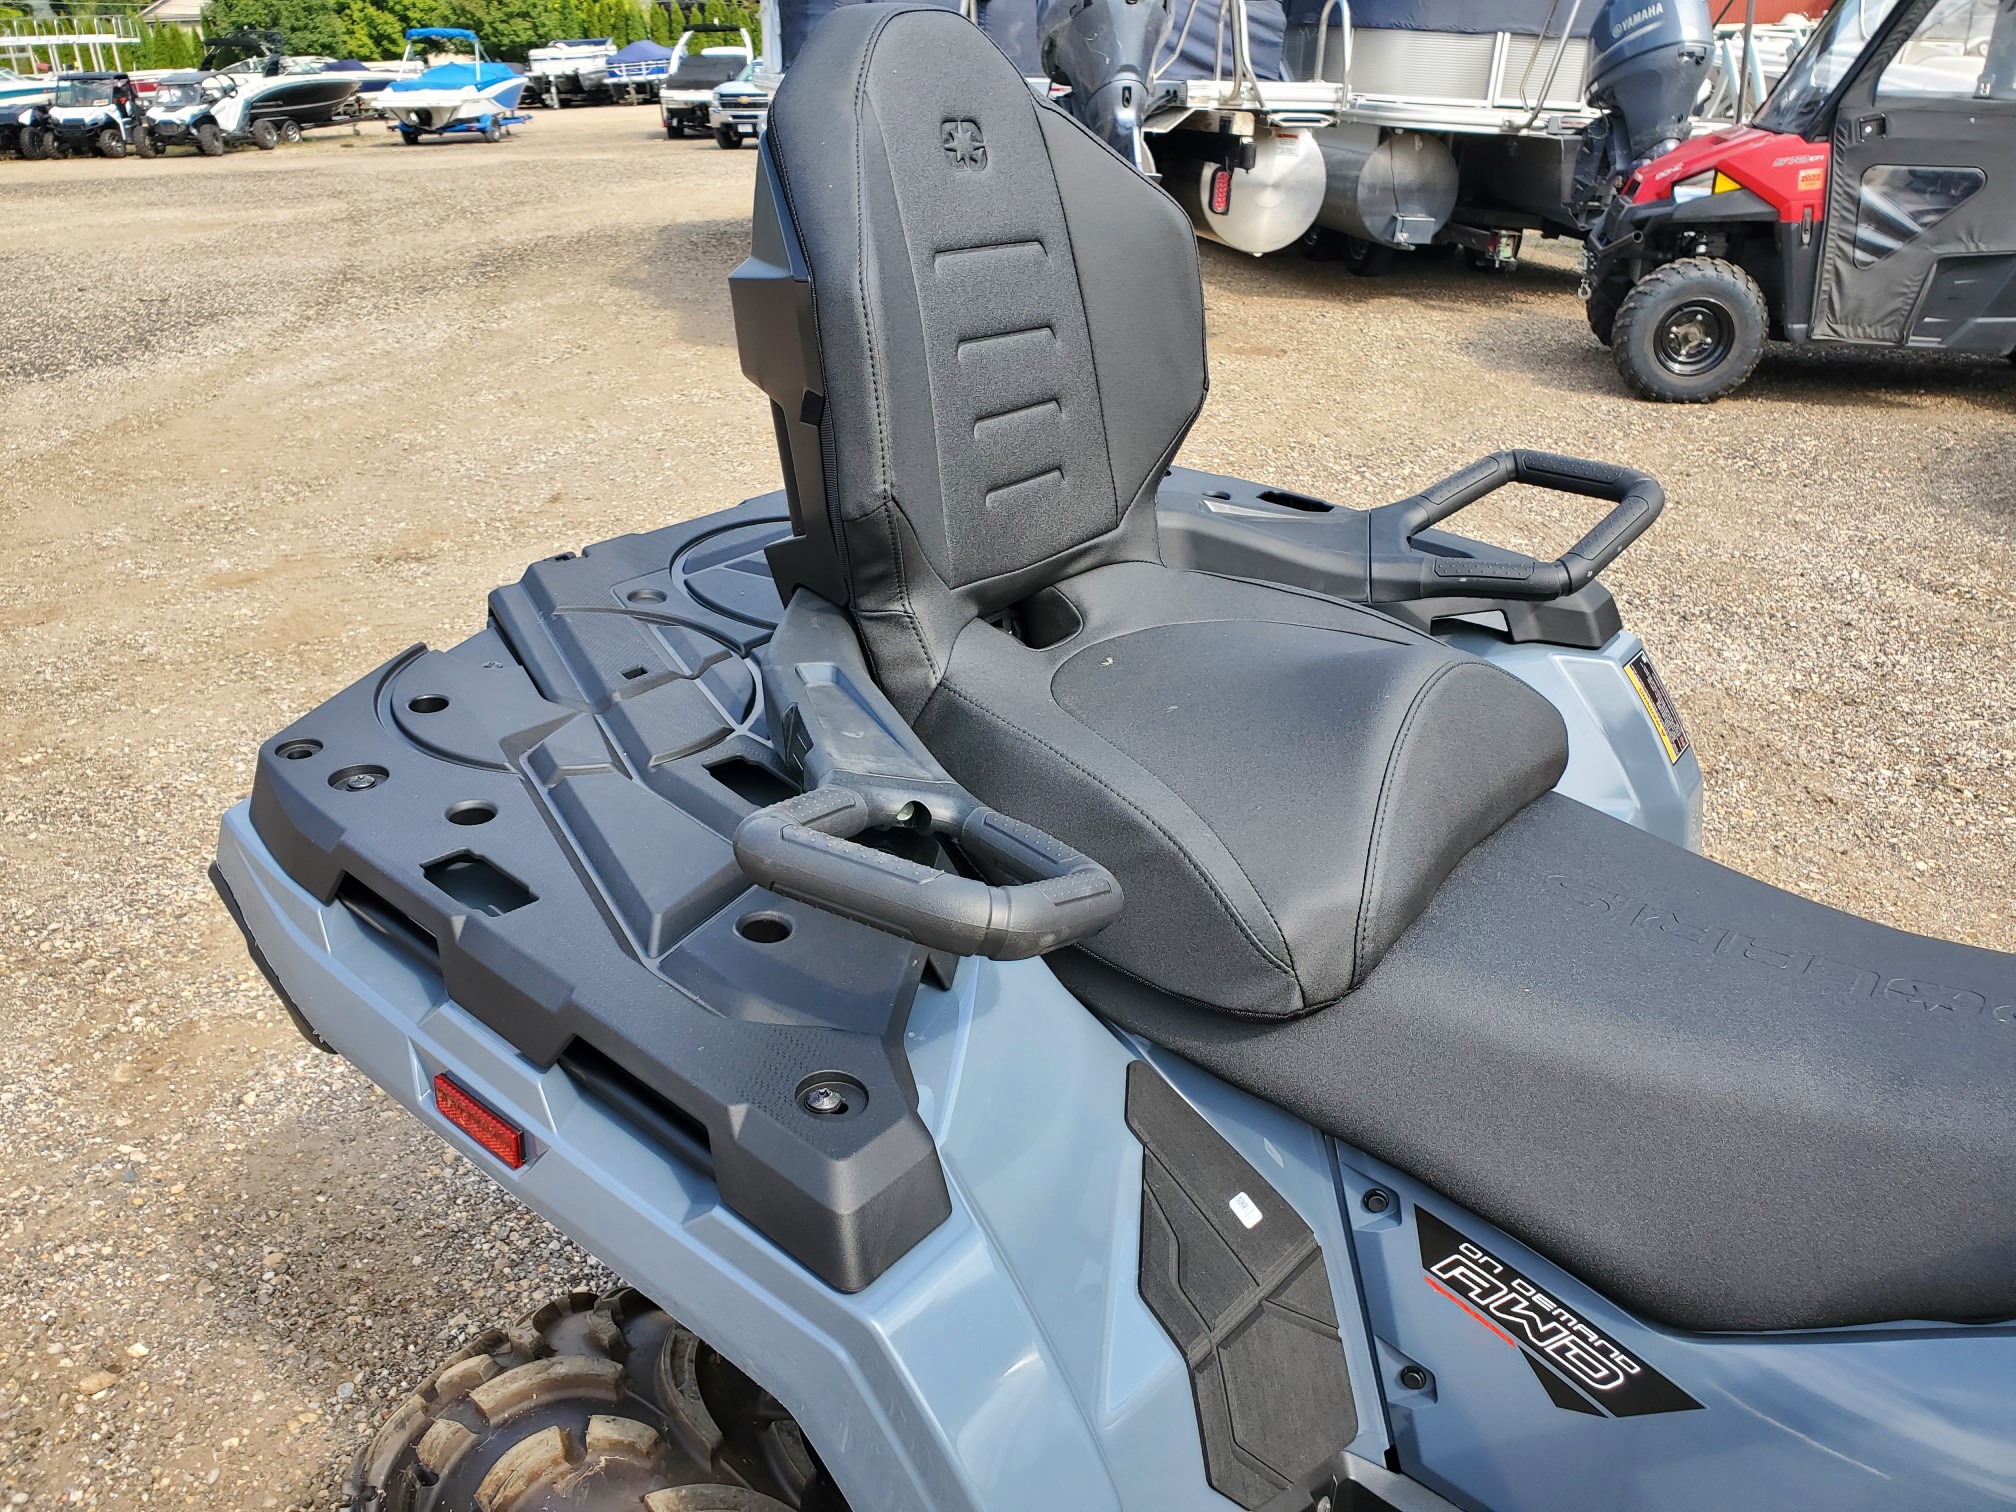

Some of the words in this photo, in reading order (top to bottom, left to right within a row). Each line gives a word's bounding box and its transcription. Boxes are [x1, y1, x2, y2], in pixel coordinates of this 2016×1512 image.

[1622, 2, 1664, 31] YAMAHA
[1429, 1254, 1625, 1390] AWD
[1511, 1278, 1642, 1374] DEMAND
